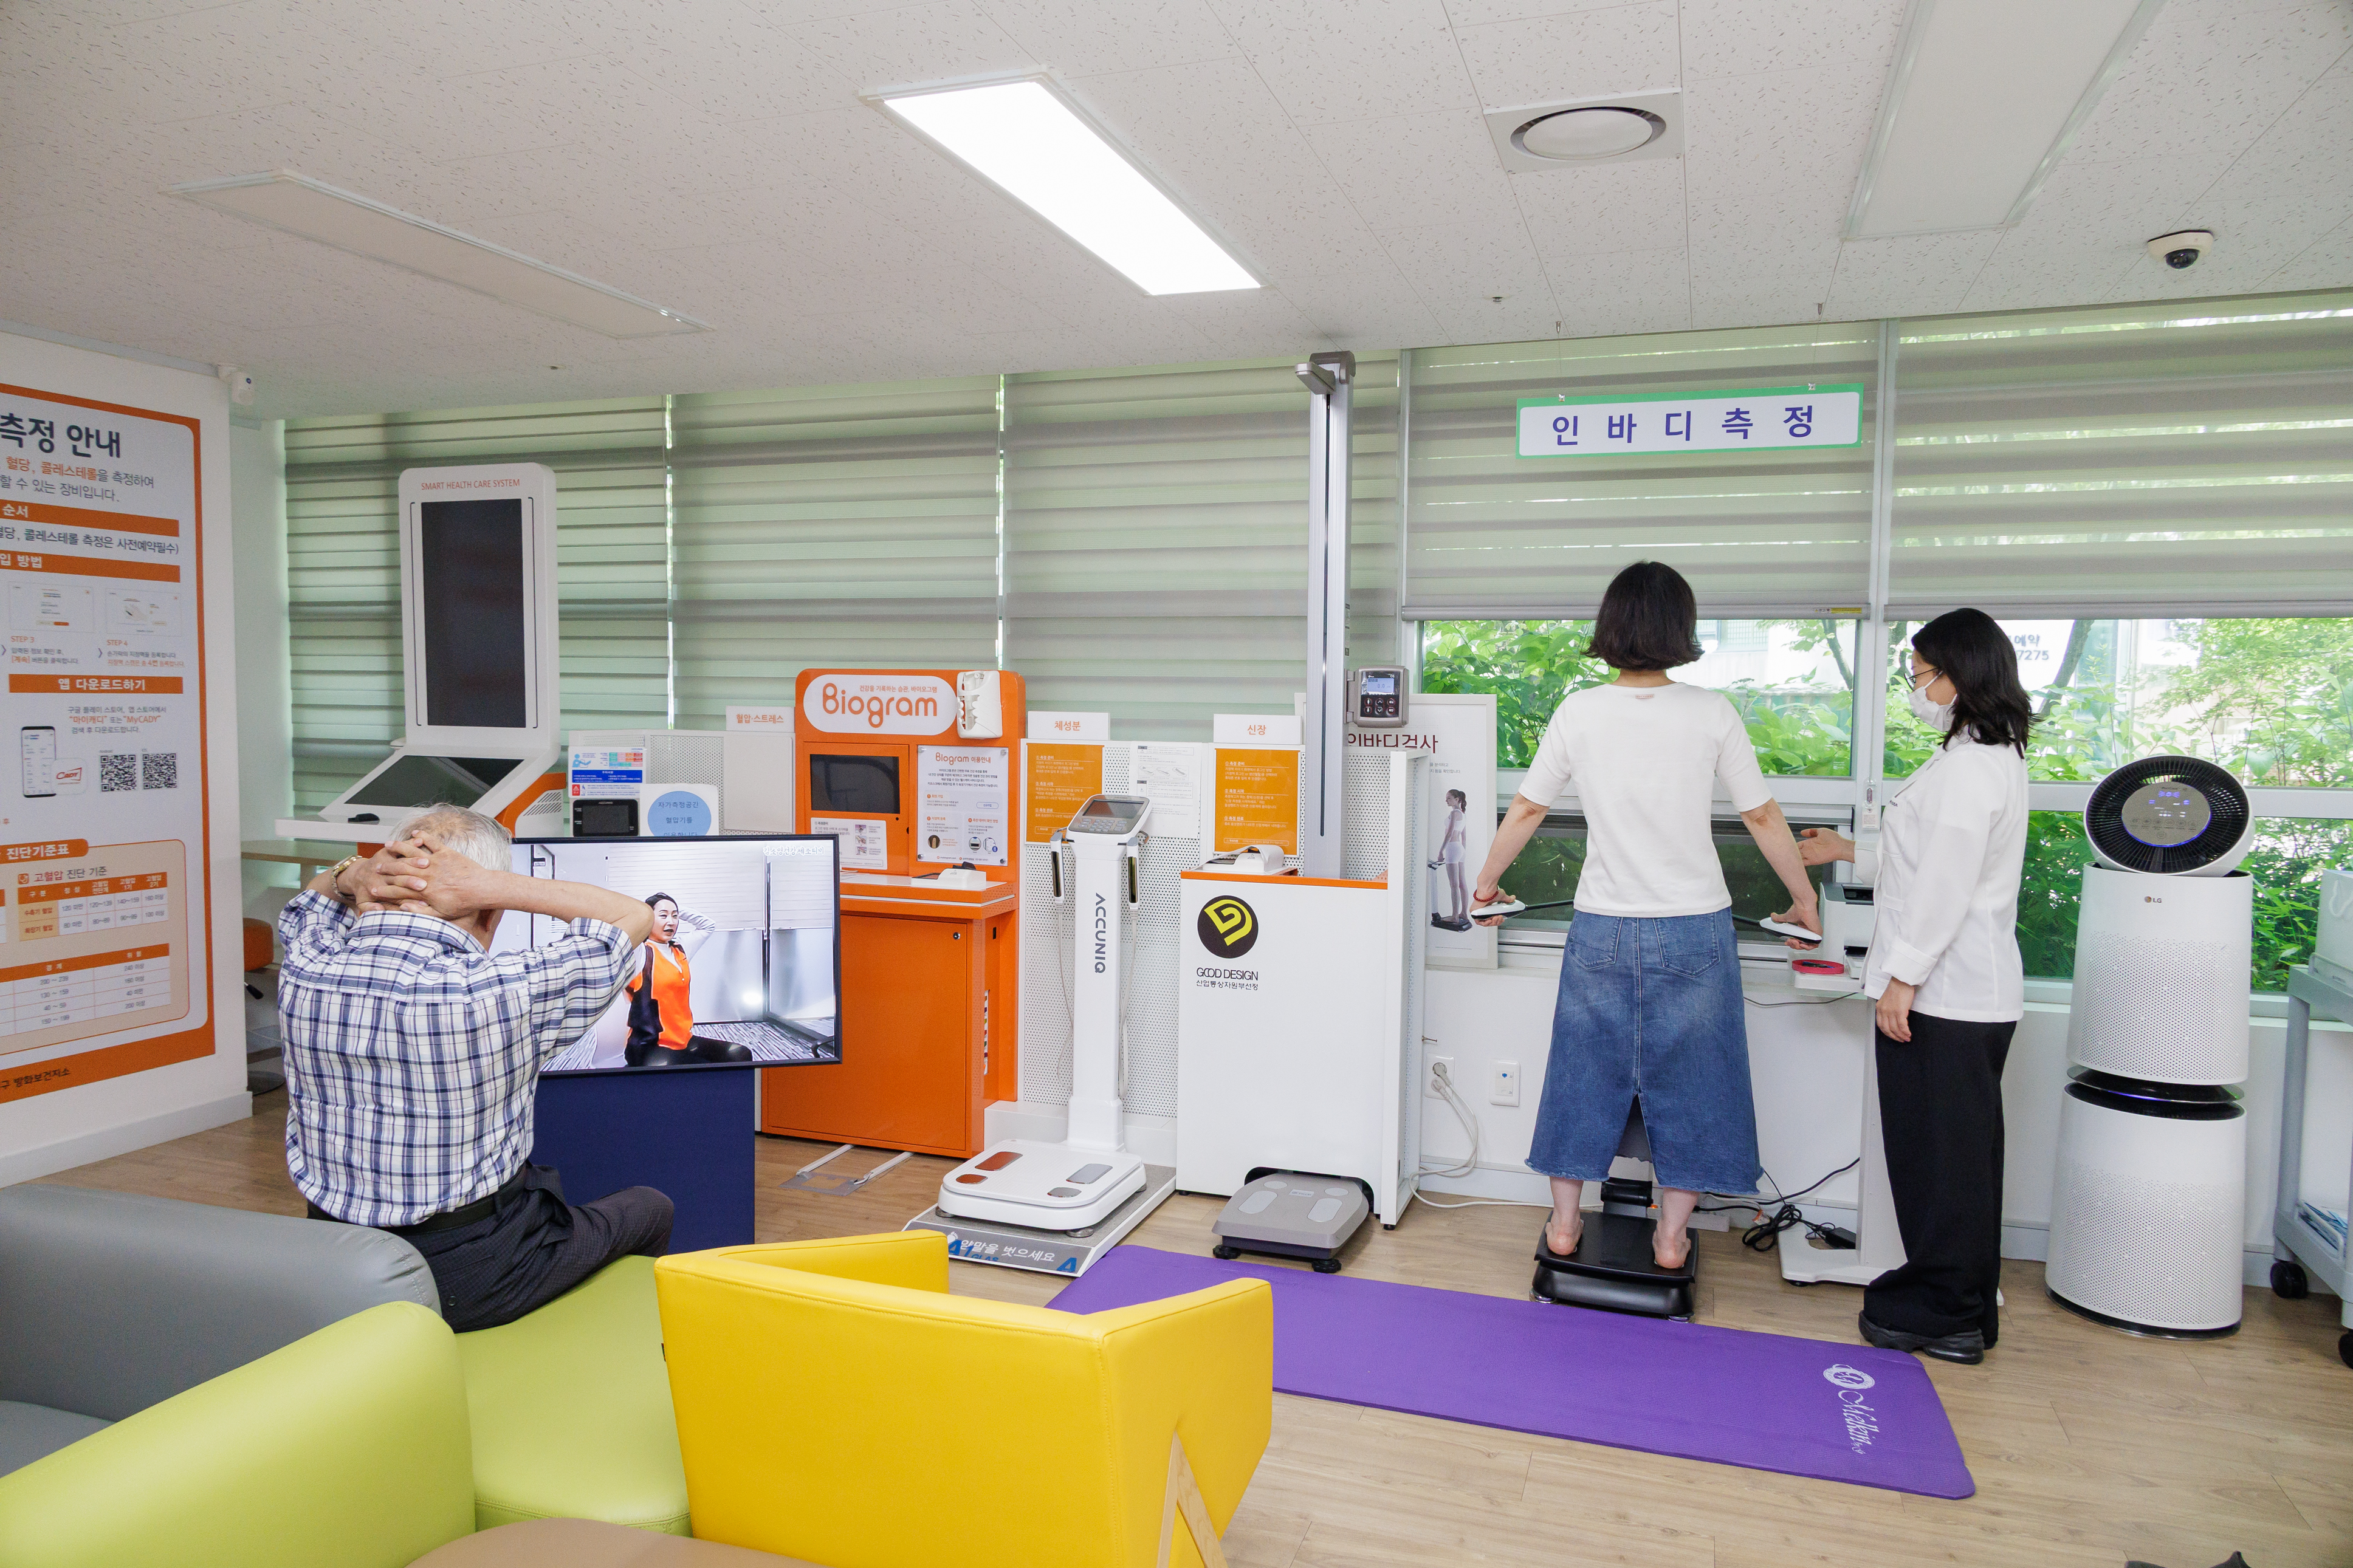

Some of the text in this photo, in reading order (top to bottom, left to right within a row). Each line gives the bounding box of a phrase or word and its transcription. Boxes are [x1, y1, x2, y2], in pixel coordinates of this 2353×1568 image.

[0, 413, 120, 458] 측정 안내
[6, 456, 154, 488] 혈당, 콜레스테롤을 측정하여
[16, 478, 28, 491] 수
[32, 479, 55, 495] 있는
[60, 483, 120, 502] 장비입니다.
[421, 479, 520, 490] SMART HEALTH CARE SYSTEM
[2, 504, 29, 518] 순서
[25, 528, 179, 555] 콜레스테롤 측정은 사전예약필수)
[17, 555, 42, 568] 방법
[58, 679, 145, 691] 앱 다운로드하기
[822, 682, 937, 728] Biogram
[735, 713, 784, 724] 혈압·스트레스
[1054, 720, 1081, 731] 체성분
[1247, 725, 1266, 735] 신장
[936, 752, 969, 765] Biogram
[6, 844, 69, 860] 진단기준표
[34, 866, 107, 882] 고혈압 진단 기준
[1094, 892, 1106, 974] ACCUNIQ
[1197, 967, 1258, 981] GOOD DESIGN
[1196, 980, 1258, 991] 산업통상자원부선정
[13, 1067, 70, 1087] 방화보건지소
[960, 1239, 1055, 1262] 양말을 벗으세요
